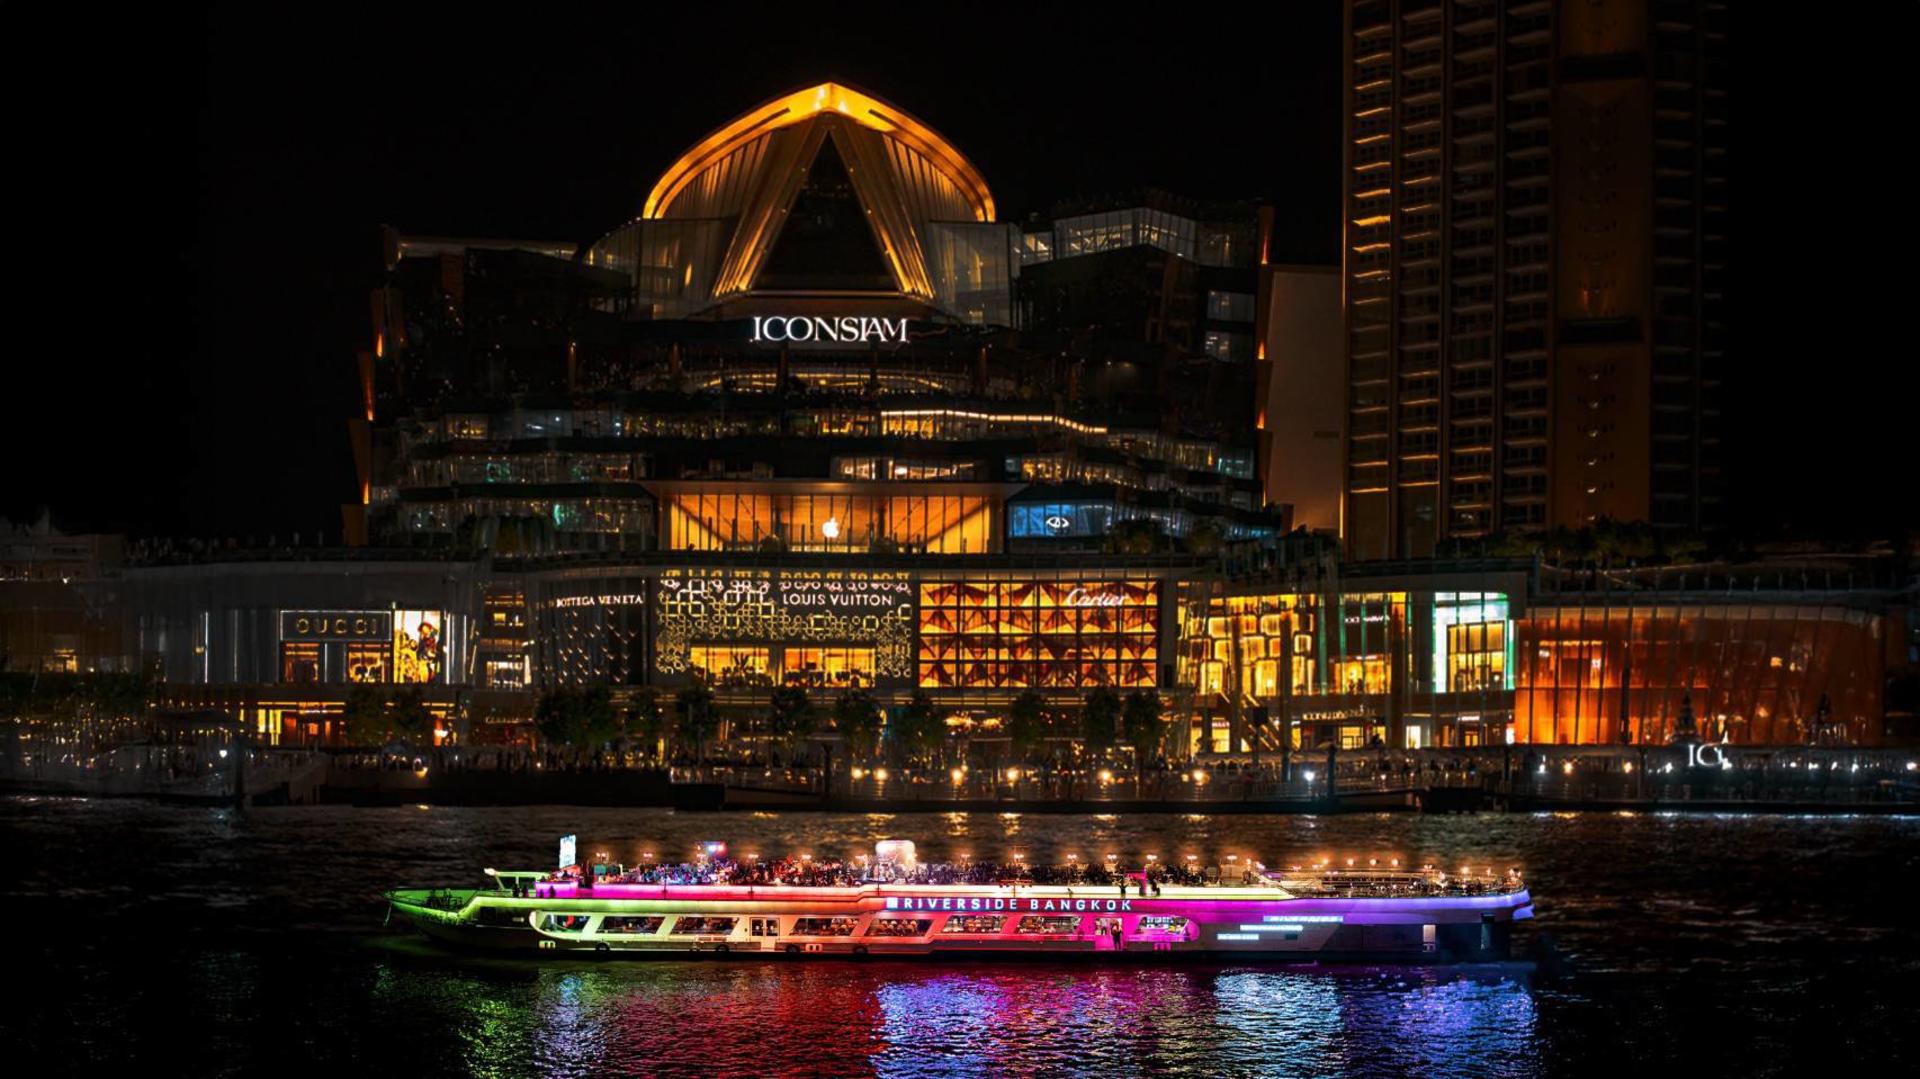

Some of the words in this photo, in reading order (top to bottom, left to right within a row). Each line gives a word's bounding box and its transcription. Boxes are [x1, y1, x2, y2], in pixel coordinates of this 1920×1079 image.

[753, 316, 908, 342] ICONSIAM
[556, 596, 595, 608] BOTTEGA
[598, 594, 644, 605] VENETA
[783, 593, 826, 606] LOUIS
[830, 593, 892, 606] VUITTON
[1066, 587, 1125, 606] Cartier
[296, 618, 377, 635] GUCCI
[904, 898, 1018, 910] RIVERSIDE
[1030, 900, 1131, 911] BANGKOK
